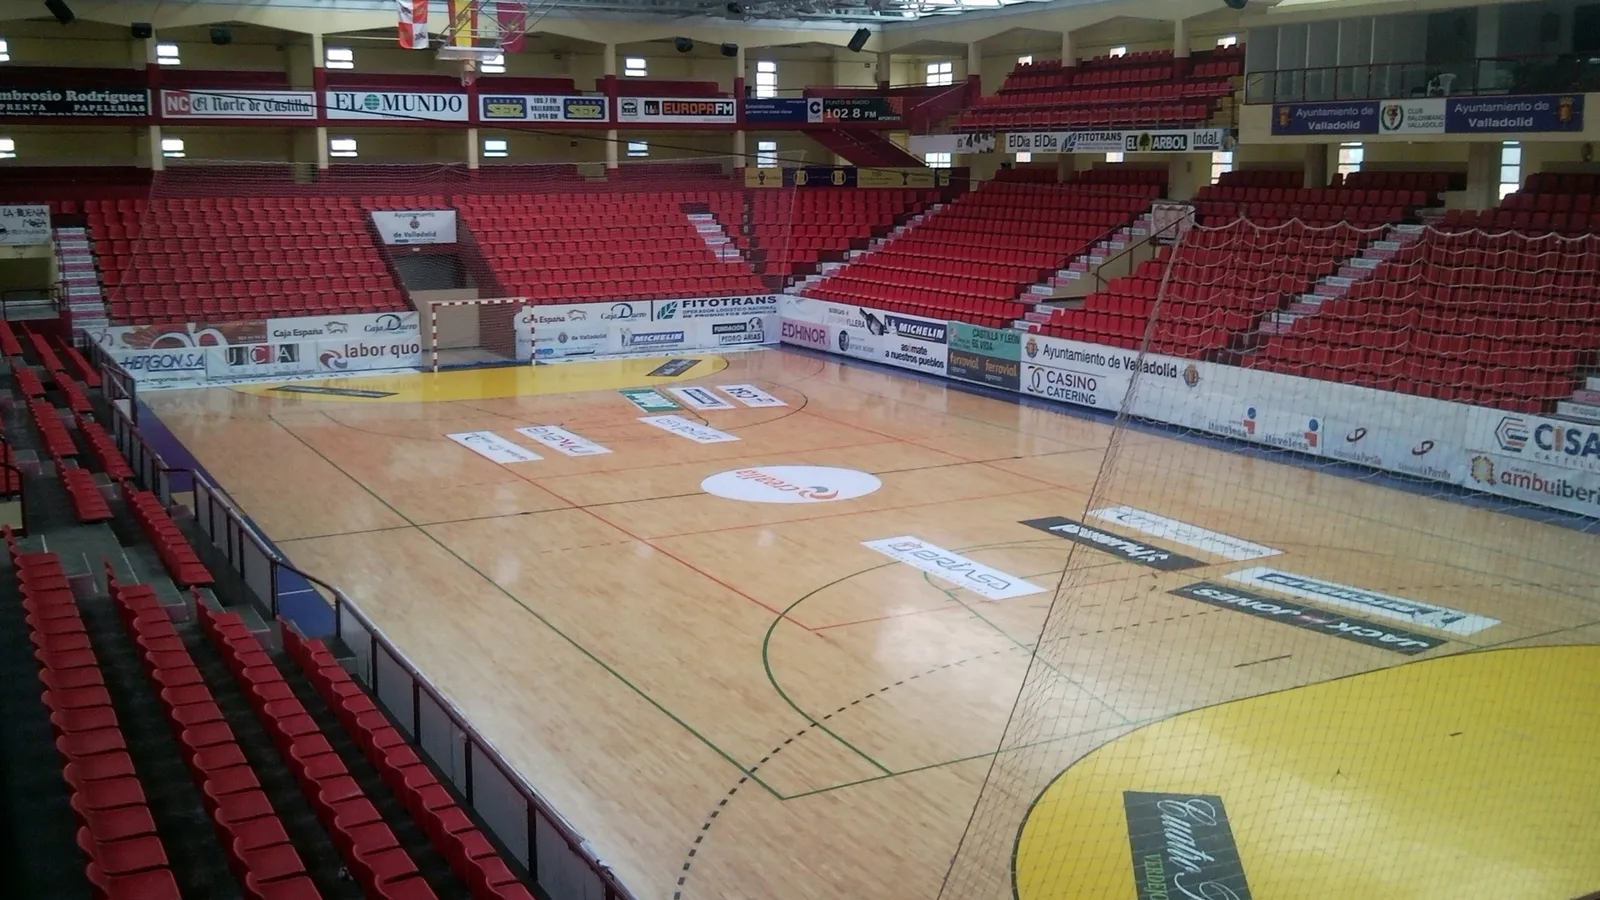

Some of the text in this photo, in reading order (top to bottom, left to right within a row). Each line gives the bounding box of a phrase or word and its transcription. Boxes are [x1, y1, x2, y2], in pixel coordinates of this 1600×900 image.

[167, 96, 190, 111] NC
[335, 92, 462, 112] EL MUNDO
[1454, 101, 1550, 114] Ayuntamiento de
[1296, 106, 1374, 119] Ayuntamiento de
[1308, 120, 1360, 130] Valladolid
[1468, 117, 1534, 128] Valladolid
[1078, 132, 1122, 142] FITOTRANS
[1126, 138, 1136, 150] EL
[682, 296, 777, 308] FITOTRANS
[274, 329, 292, 340] Caja
[293, 328, 324, 338] España
[634, 332, 682, 342] MICHELIN
[722, 333, 761, 342] PEDRO ARIAS
[782, 322, 826, 346] EDHINOR
[899, 322, 944, 339] MICHELIN
[972, 328, 998, 341] CASTILLA
[345, 342, 420, 358] labor quo
[891, 351, 918, 364] nuestros
[918, 356, 944, 369] pueblos
[950, 352, 1018, 376] ferrovial ferrovial
[1043, 344, 1178, 378] Ayuntamiento de Valladolid
[1046, 370, 1097, 392] CASINO
[1046, 386, 1096, 405] CATERING
[1192, 588, 1430, 649] JACK JONES
[1157, 798, 1218, 873] Cuatro
